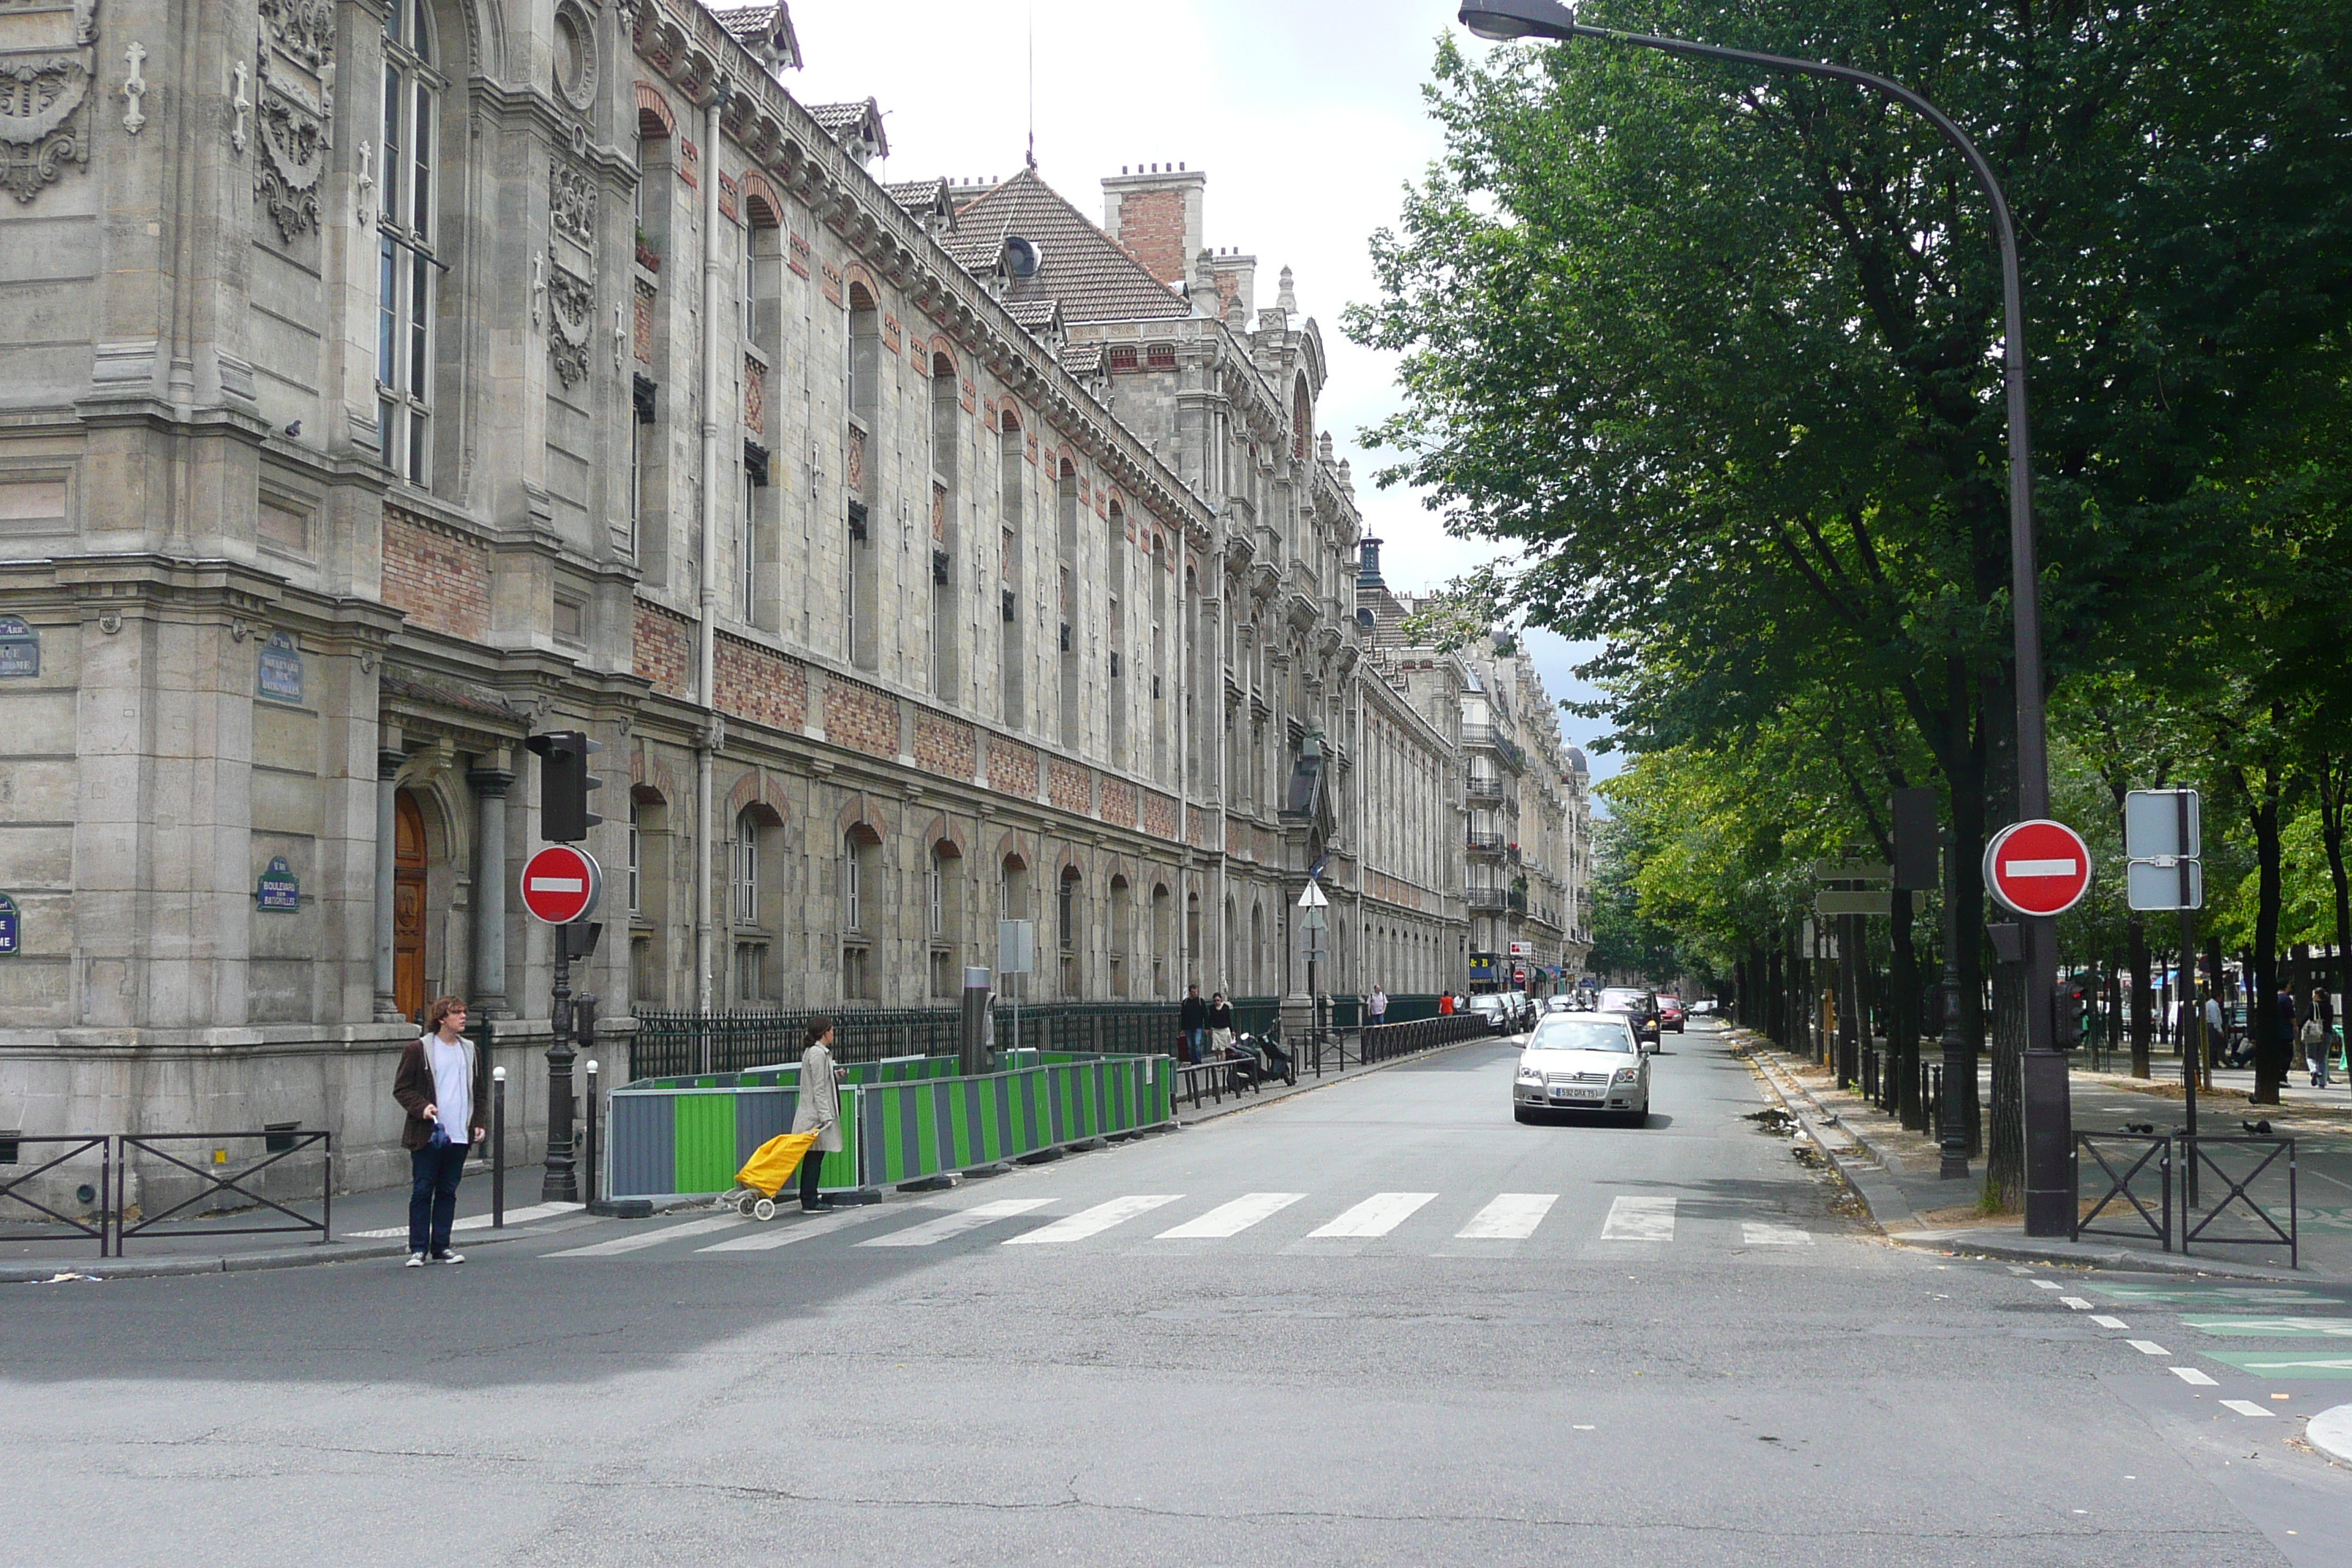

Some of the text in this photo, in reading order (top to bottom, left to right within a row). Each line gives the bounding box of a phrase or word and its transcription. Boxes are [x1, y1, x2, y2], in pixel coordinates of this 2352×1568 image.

[263, 881, 295, 892] BOULEVARD
[264, 896, 295, 905] BATIGNOLLES
[0, 938, 10, 946] ME
[1561, 1088, 1574, 1096] 592
